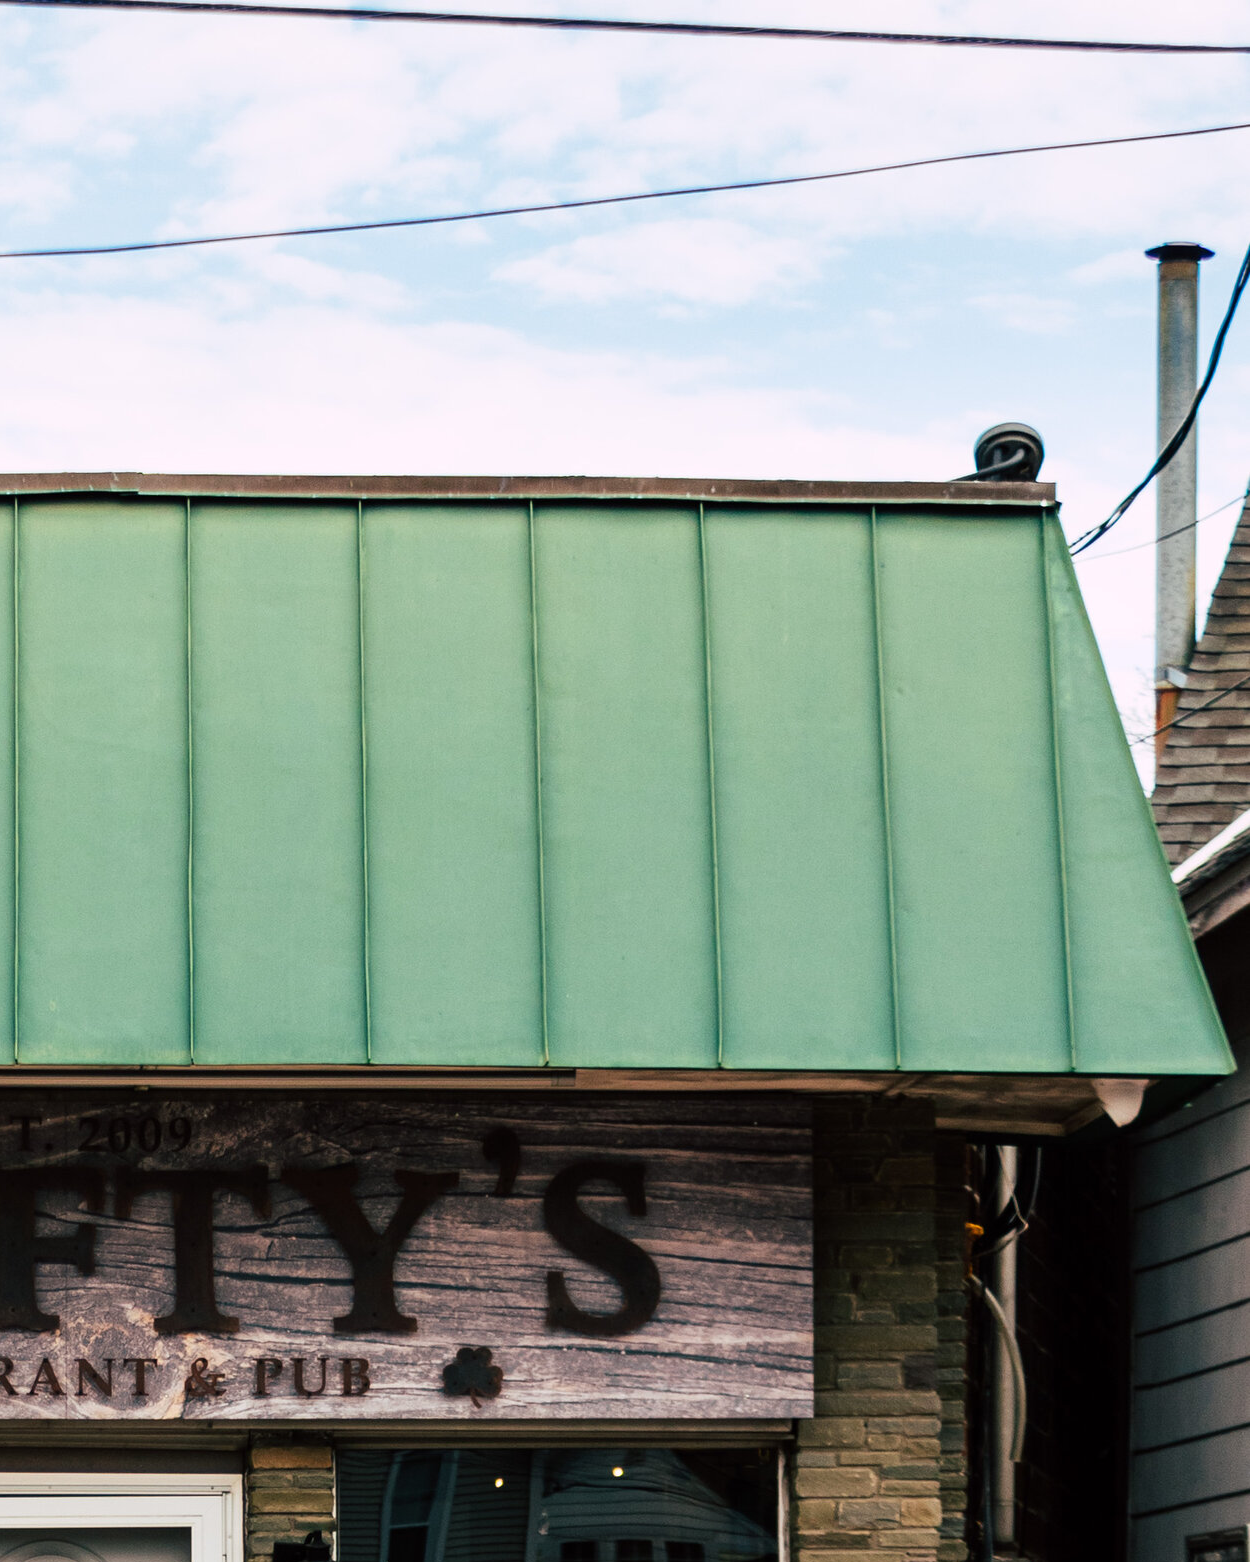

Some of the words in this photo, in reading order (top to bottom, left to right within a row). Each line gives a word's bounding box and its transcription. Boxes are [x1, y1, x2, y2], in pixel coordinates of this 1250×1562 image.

[78, 1116, 192, 1153] 2009
[185, 1356, 228, 1397] &
[252, 1356, 372, 1397] PUB
